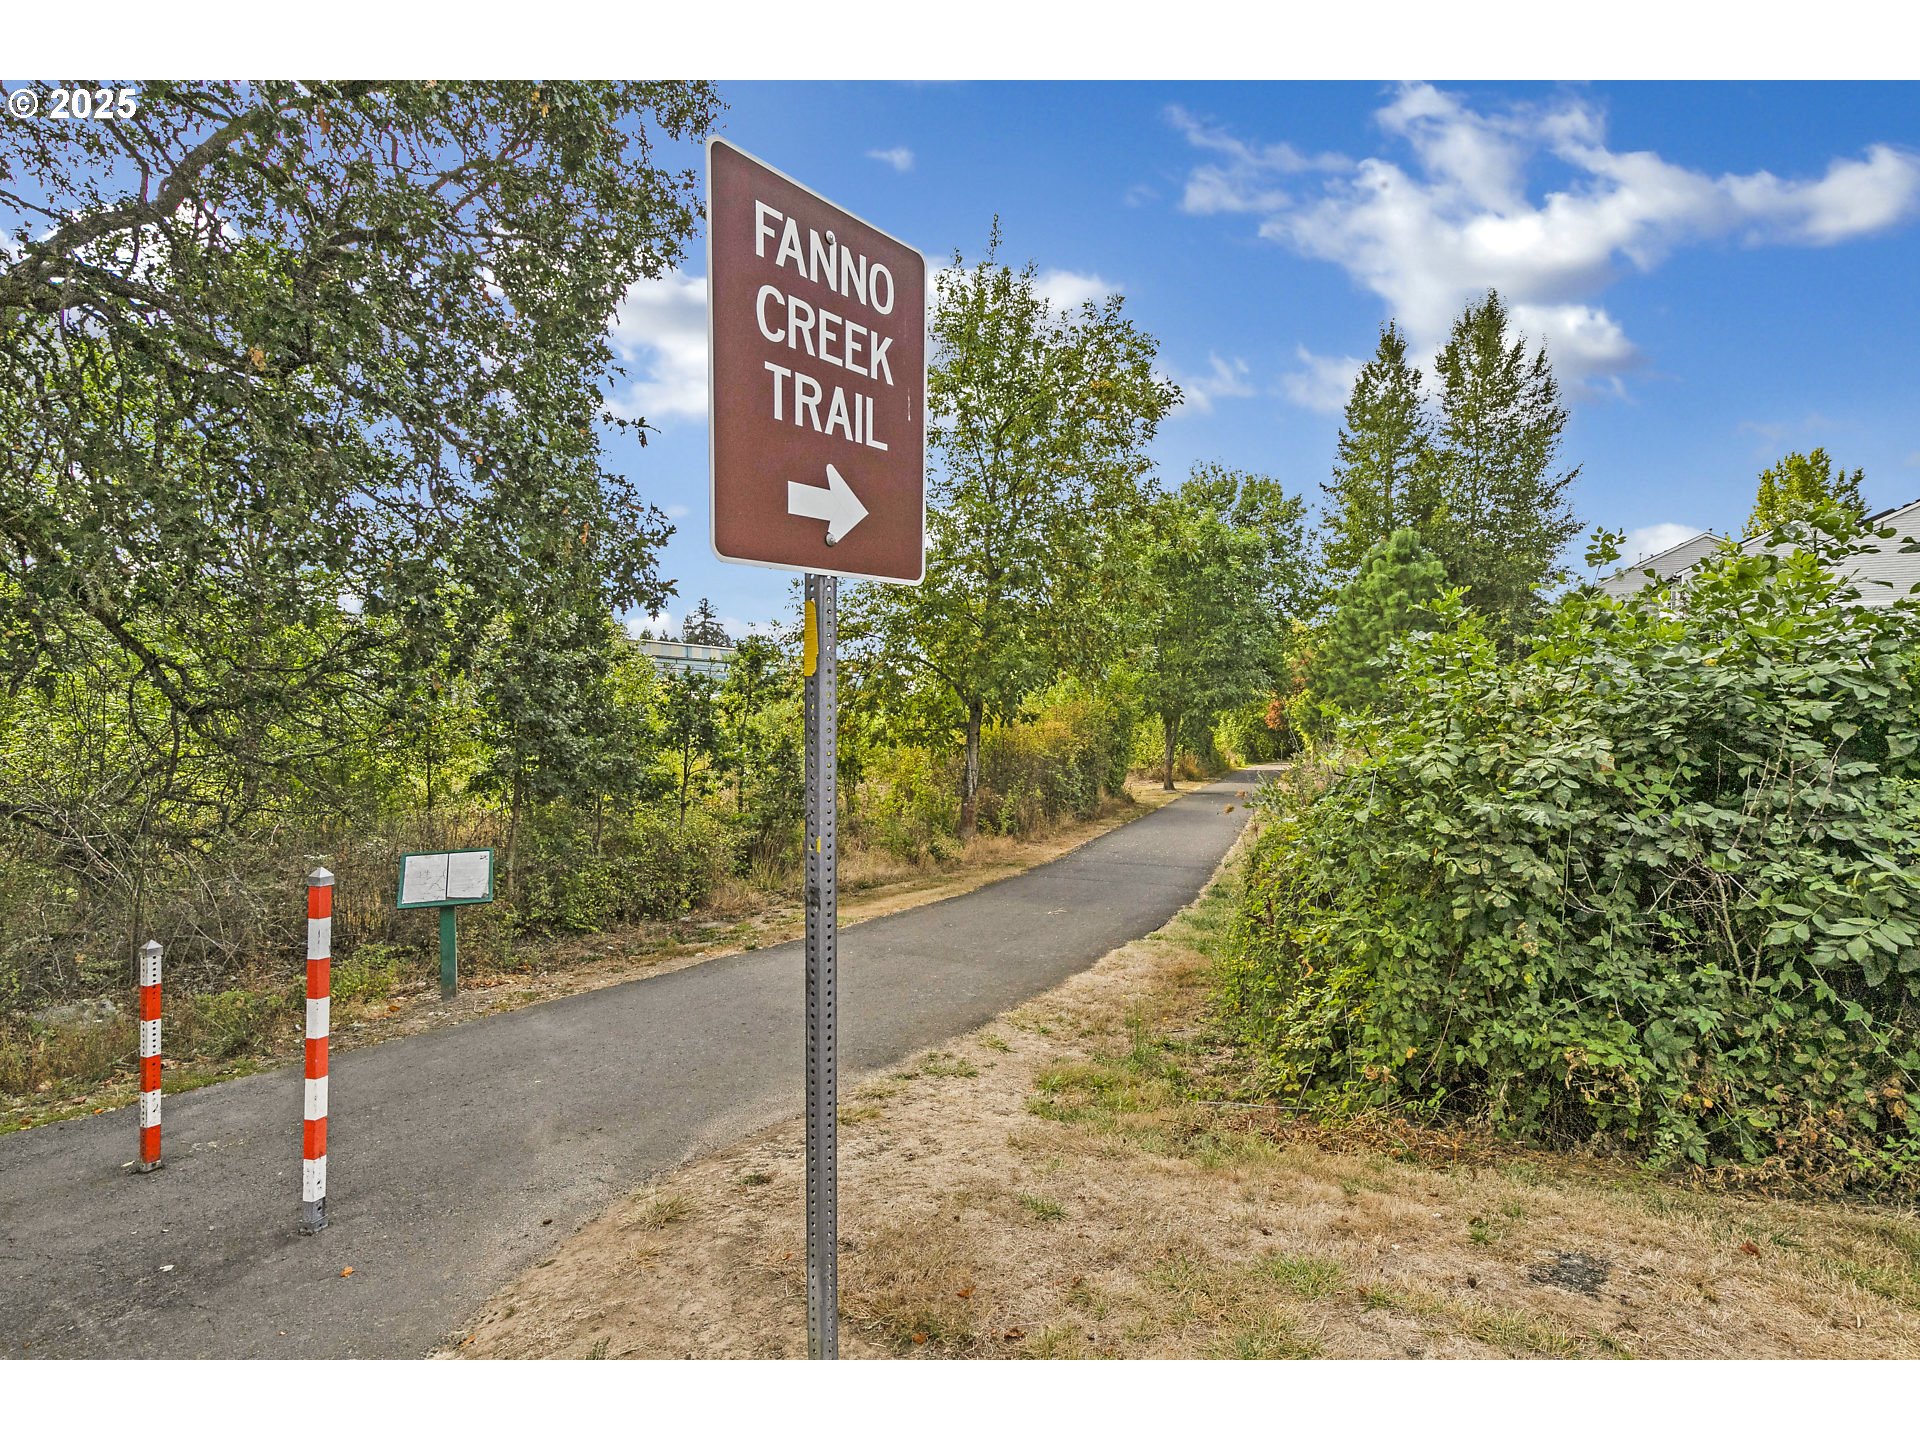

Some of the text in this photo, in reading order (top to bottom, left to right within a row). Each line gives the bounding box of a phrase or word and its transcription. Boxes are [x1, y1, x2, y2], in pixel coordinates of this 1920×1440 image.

[755, 199, 895, 315] FANNO
[756, 284, 895, 387] CREEK
[764, 360, 888, 452] TRAIL
